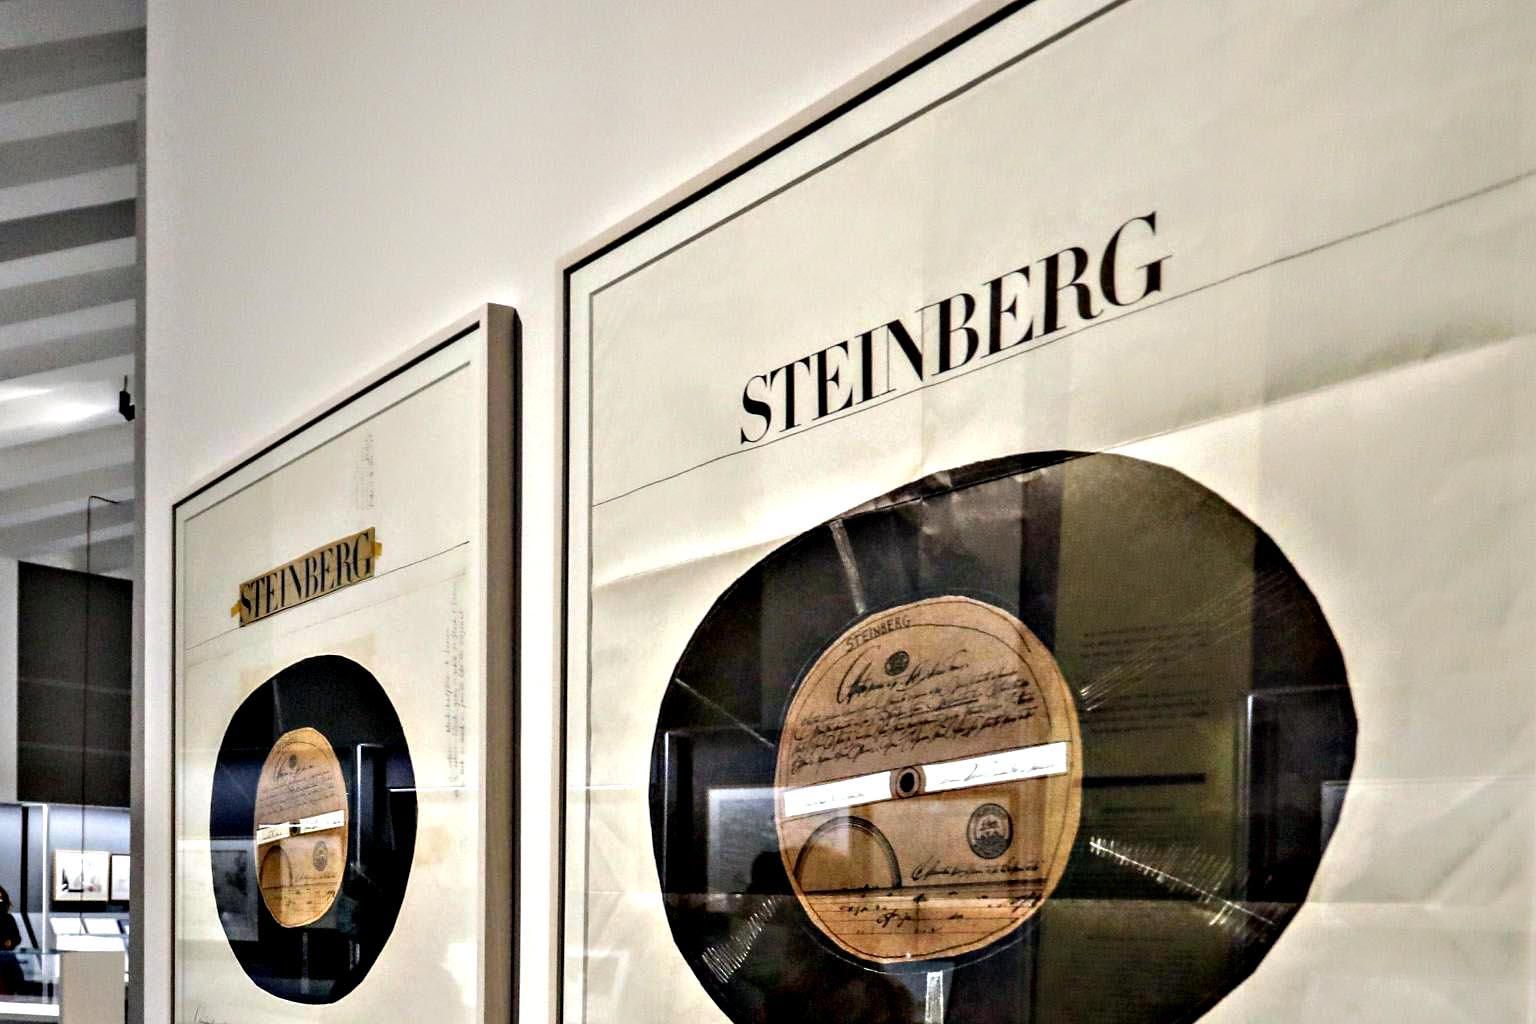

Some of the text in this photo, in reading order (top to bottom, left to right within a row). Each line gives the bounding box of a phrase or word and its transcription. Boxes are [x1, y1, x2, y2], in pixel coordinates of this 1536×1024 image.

[740, 210, 1173, 445] STEINBERG
[239, 531, 373, 628] STEINBERG
[846, 614, 912, 653] STEINBERG
